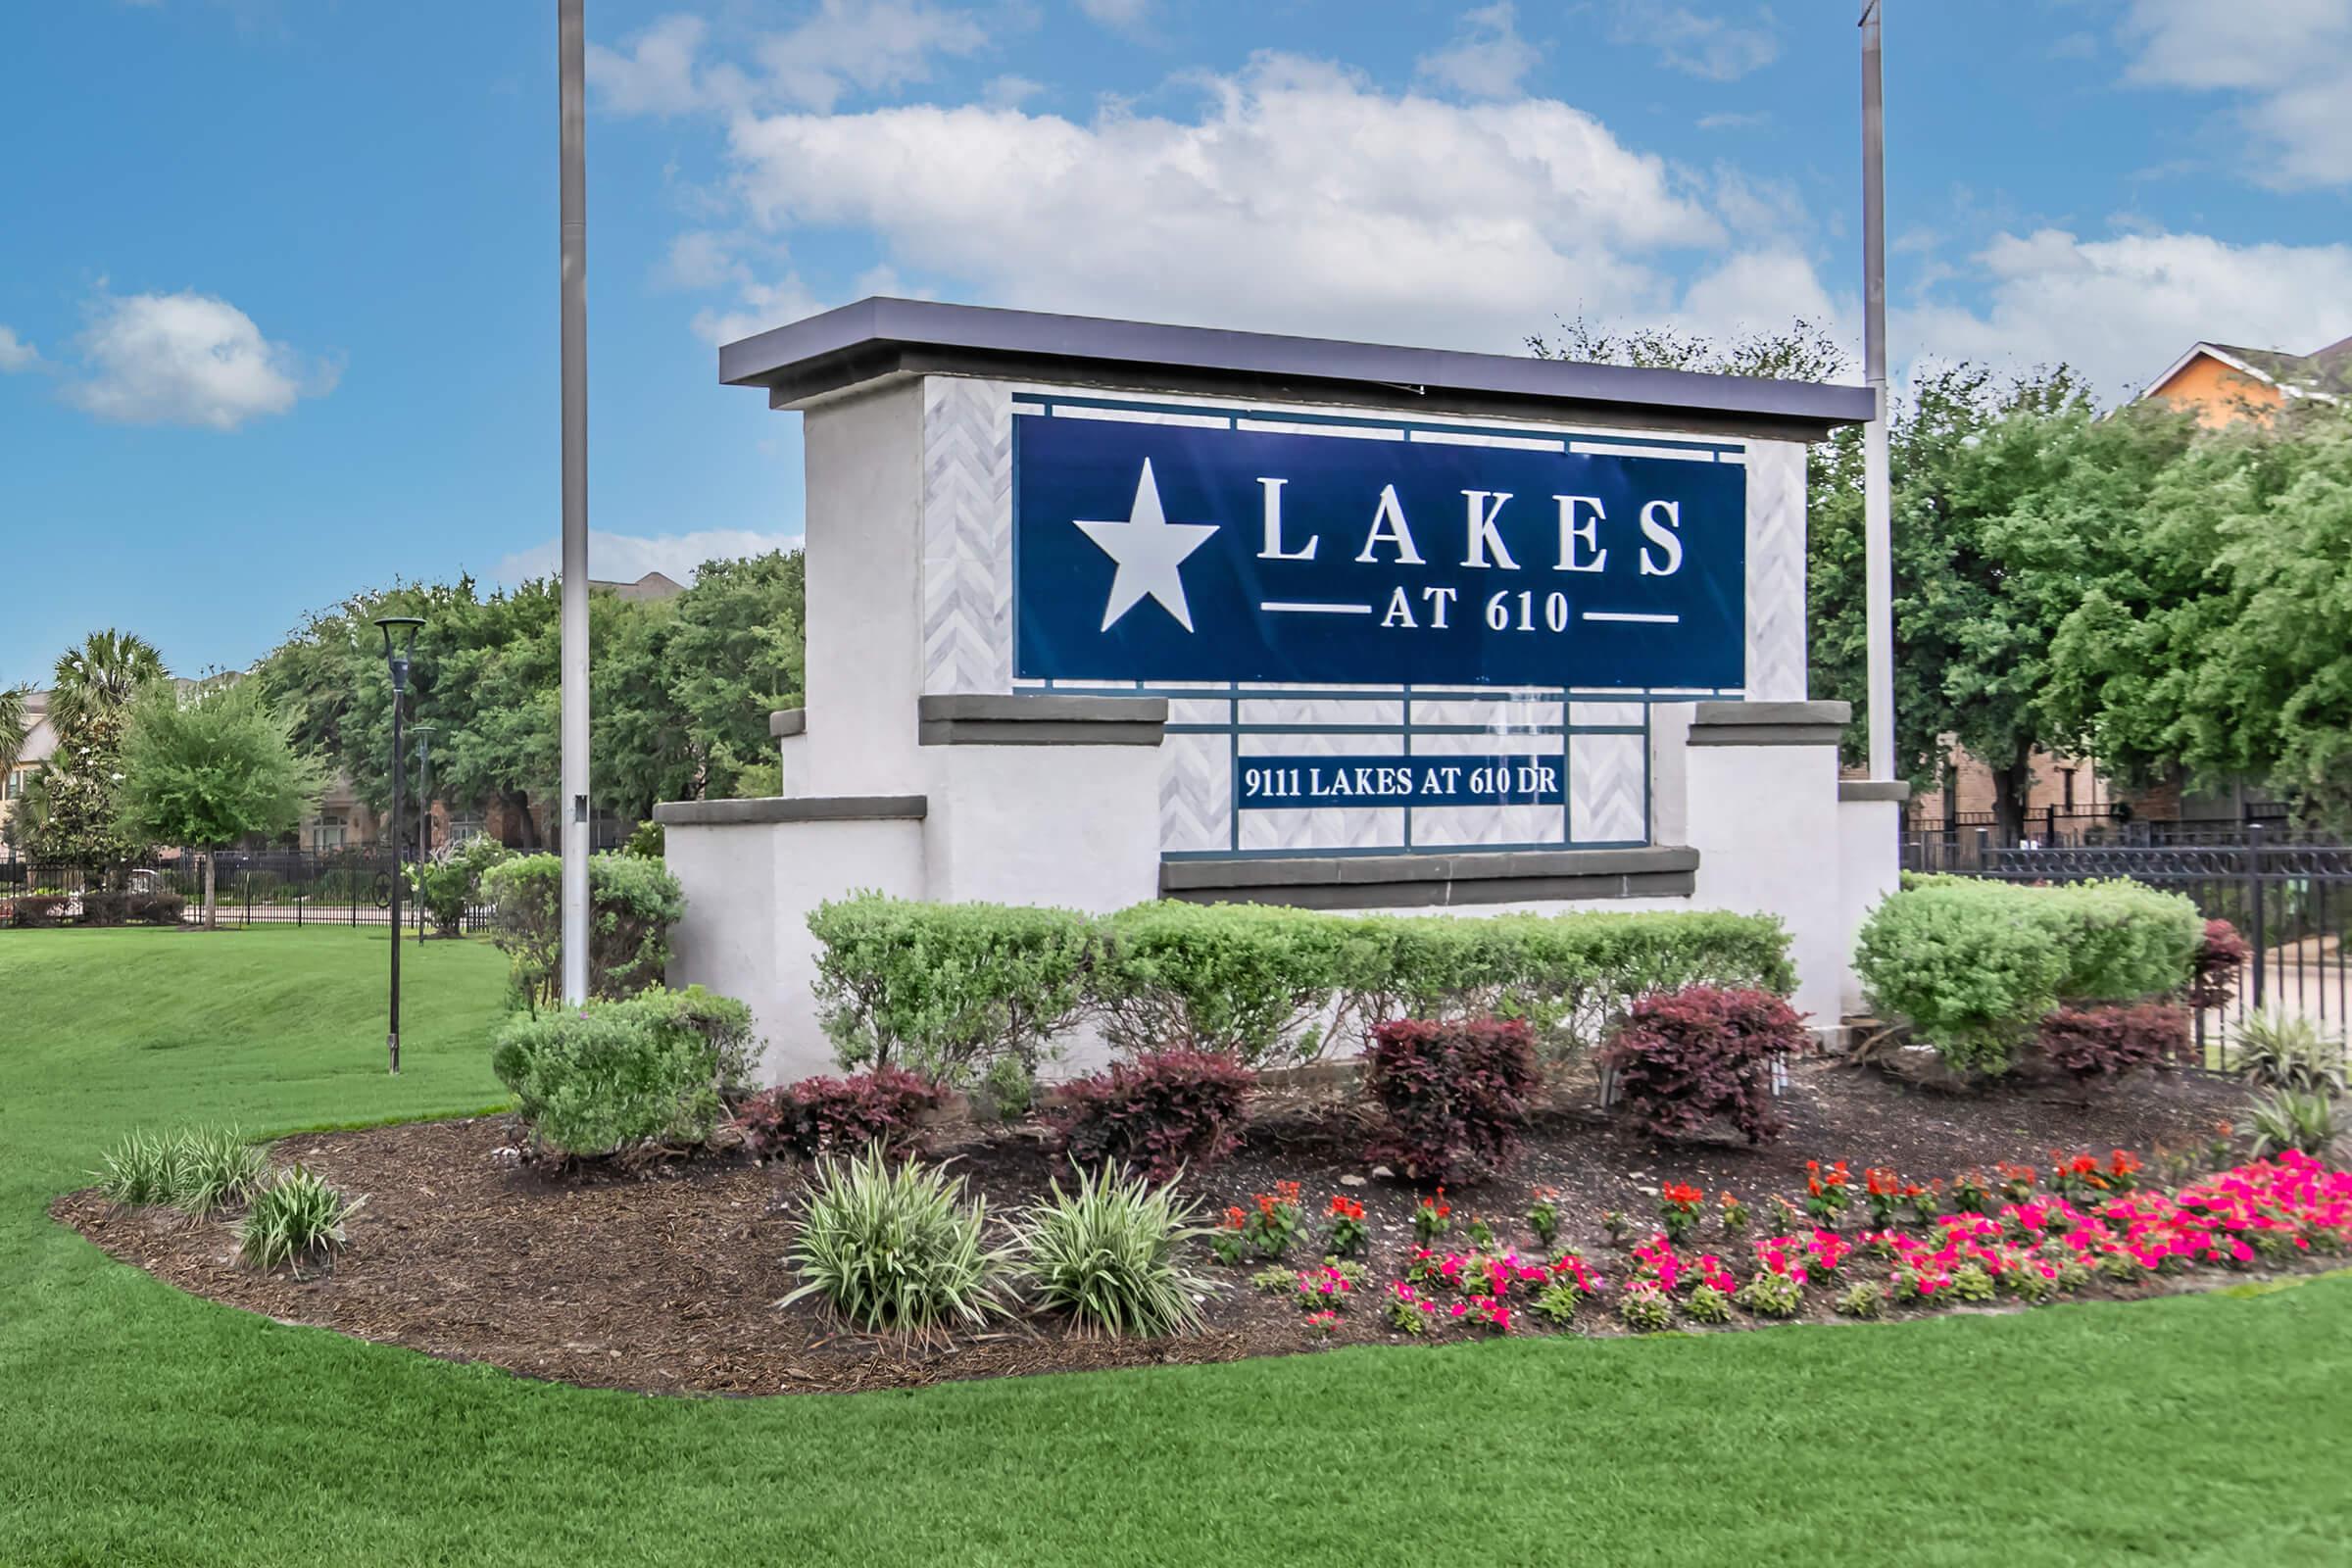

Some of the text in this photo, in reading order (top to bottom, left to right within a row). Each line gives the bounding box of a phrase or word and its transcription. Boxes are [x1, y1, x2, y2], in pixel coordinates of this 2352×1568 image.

[1256, 477, 1683, 576] LAKES
[1381, 587, 1568, 632] AT 610
[1246, 766, 1558, 797] 9111 LAKES AT 610 DR
